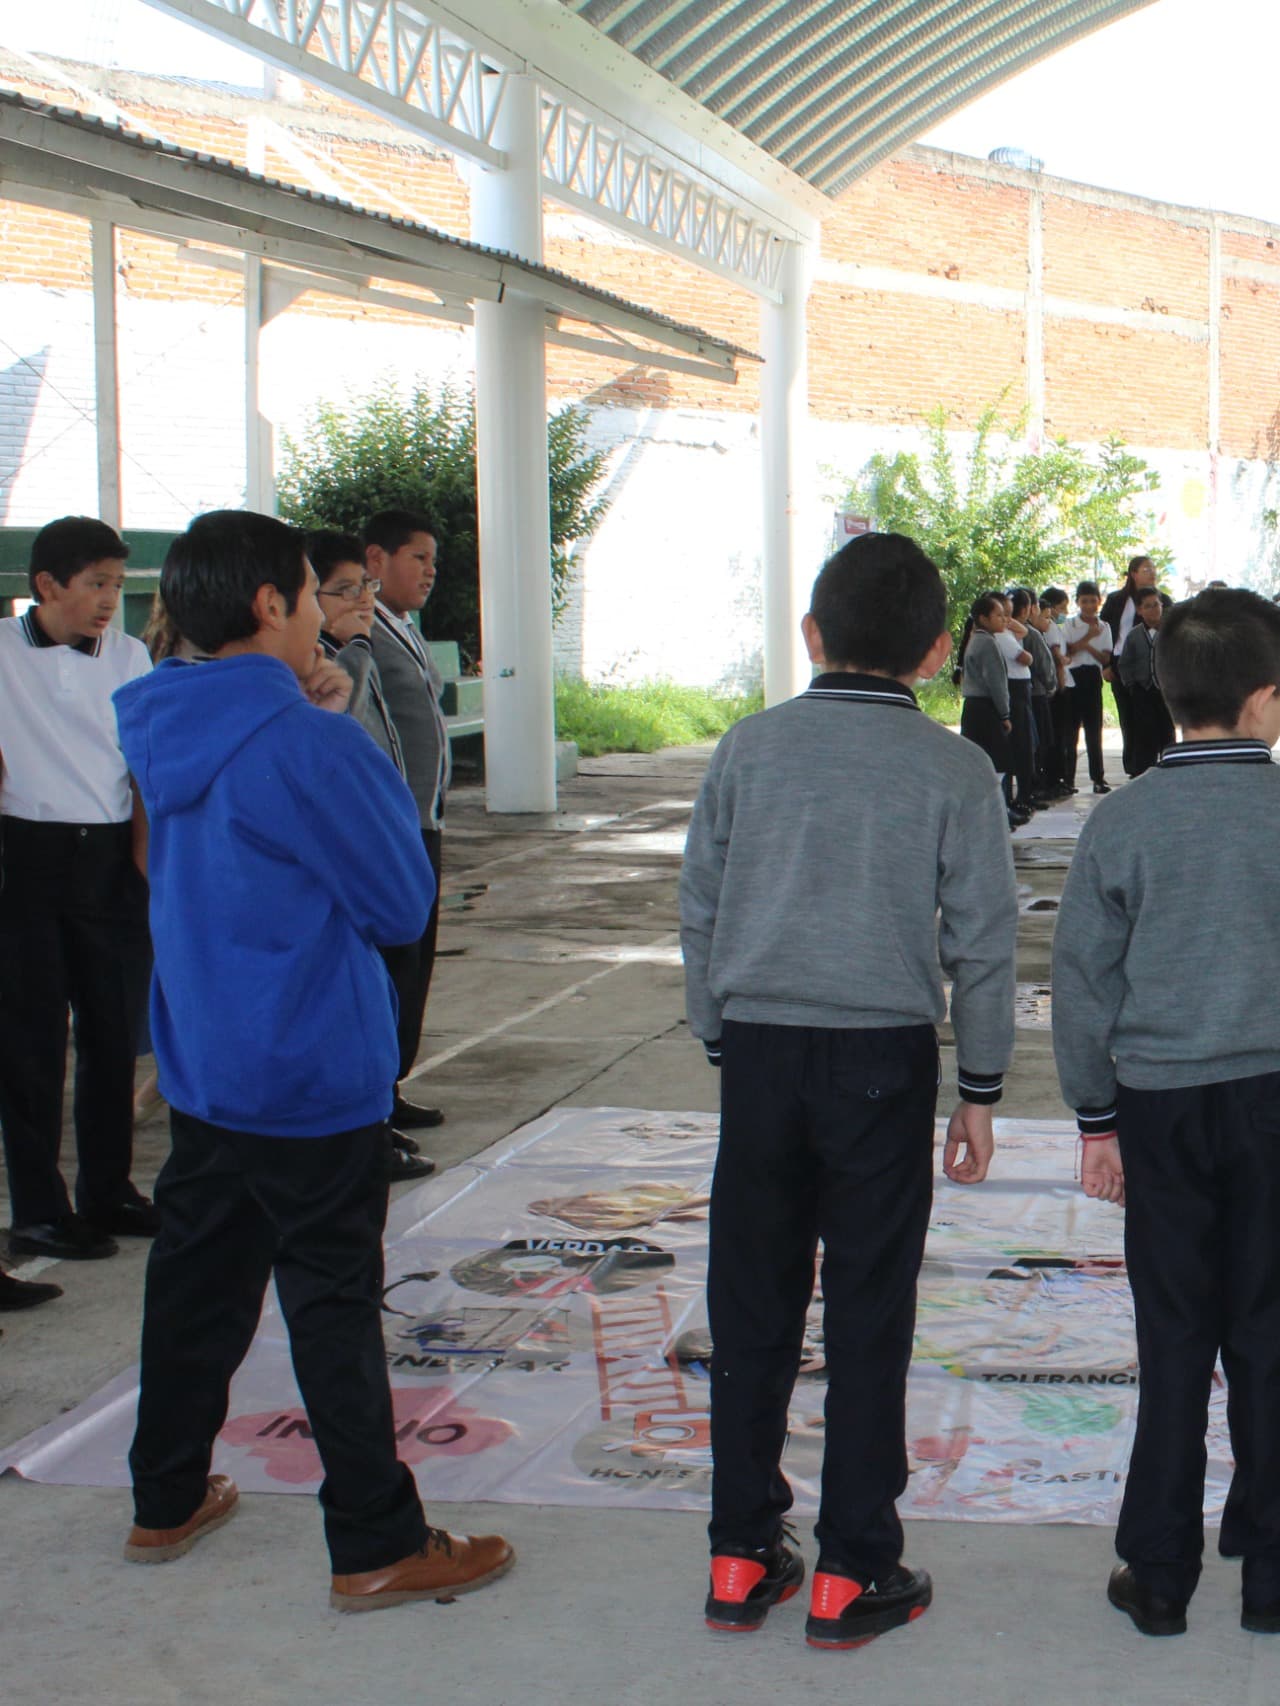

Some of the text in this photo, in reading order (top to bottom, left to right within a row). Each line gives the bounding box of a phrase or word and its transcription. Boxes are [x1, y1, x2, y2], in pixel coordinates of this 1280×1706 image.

[982, 1372, 1138, 1386] TOLERANCI
[256, 1415, 468, 1445] INIO
[1019, 1470, 1121, 1484] CASTI
